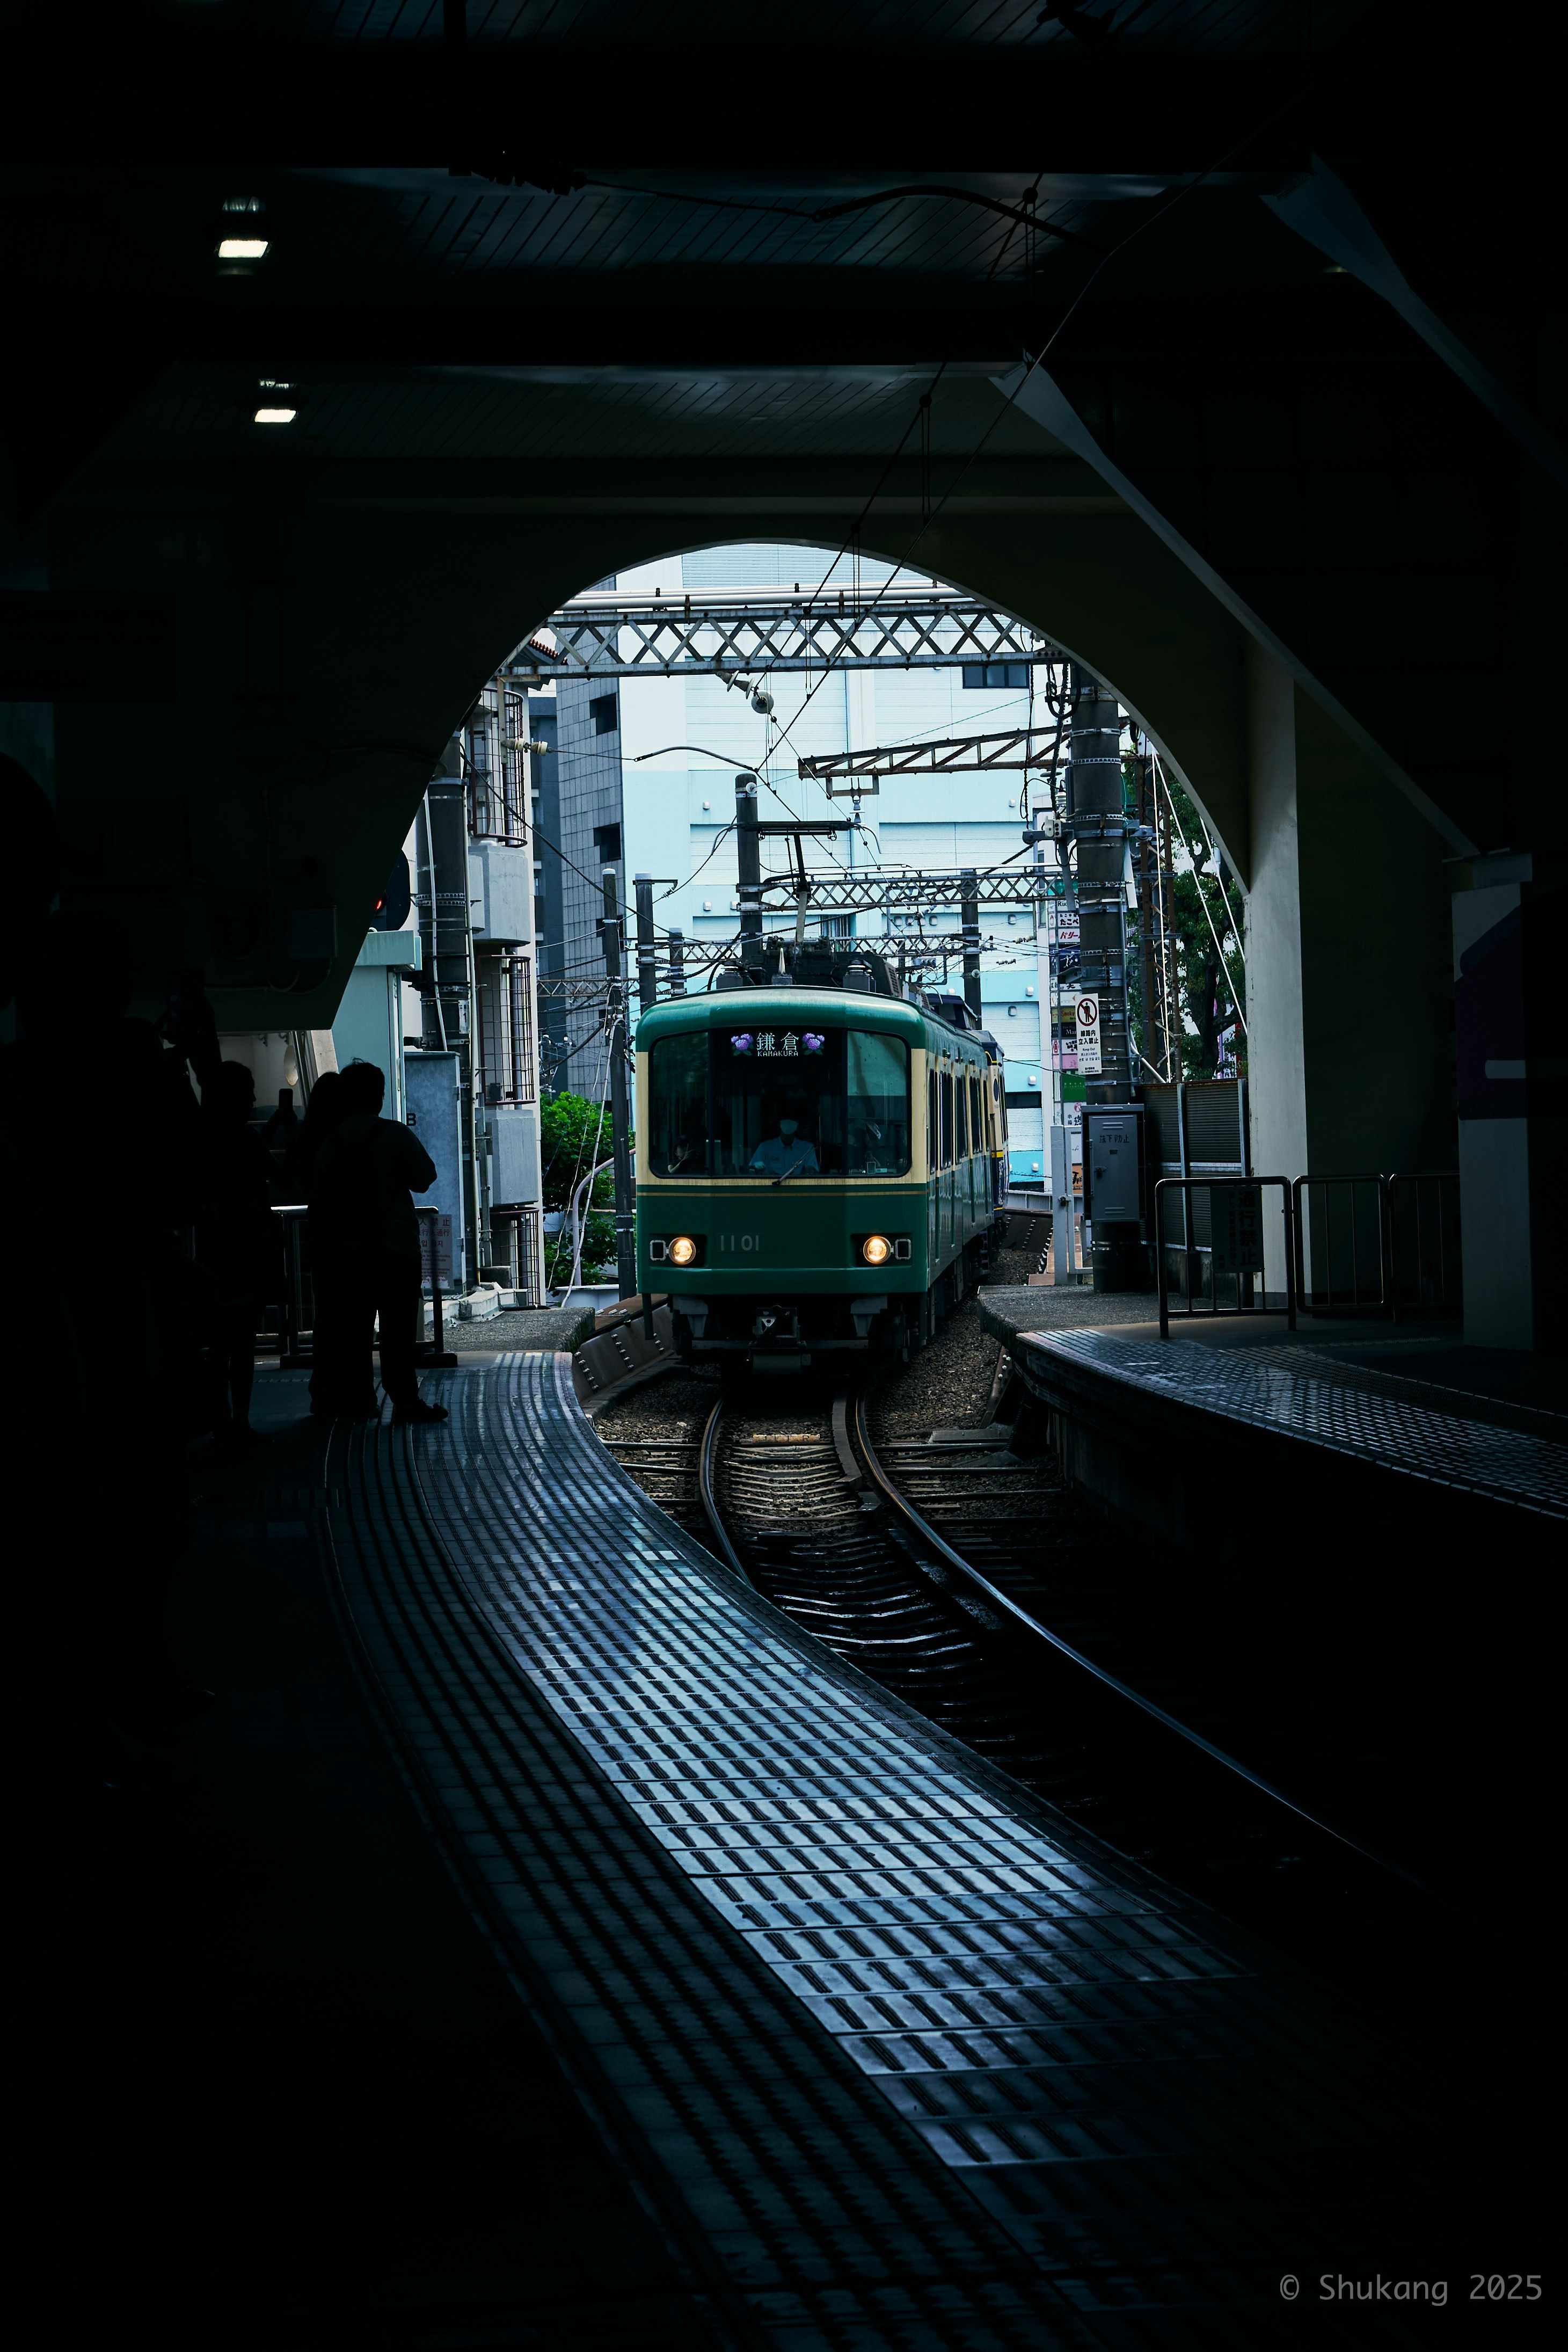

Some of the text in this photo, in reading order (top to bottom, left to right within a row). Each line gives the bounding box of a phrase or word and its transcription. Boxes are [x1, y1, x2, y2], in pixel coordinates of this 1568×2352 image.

[756, 1032, 799, 1051] 鎌倉
[406, 1113, 417, 1126] B
[1099, 1134, 1130, 1144] 落下防止
[420, 1228, 450, 1236] 行人通行
[1238, 1191, 1258, 1265] 通行禁止
[720, 1235, 759, 1251] 1101
